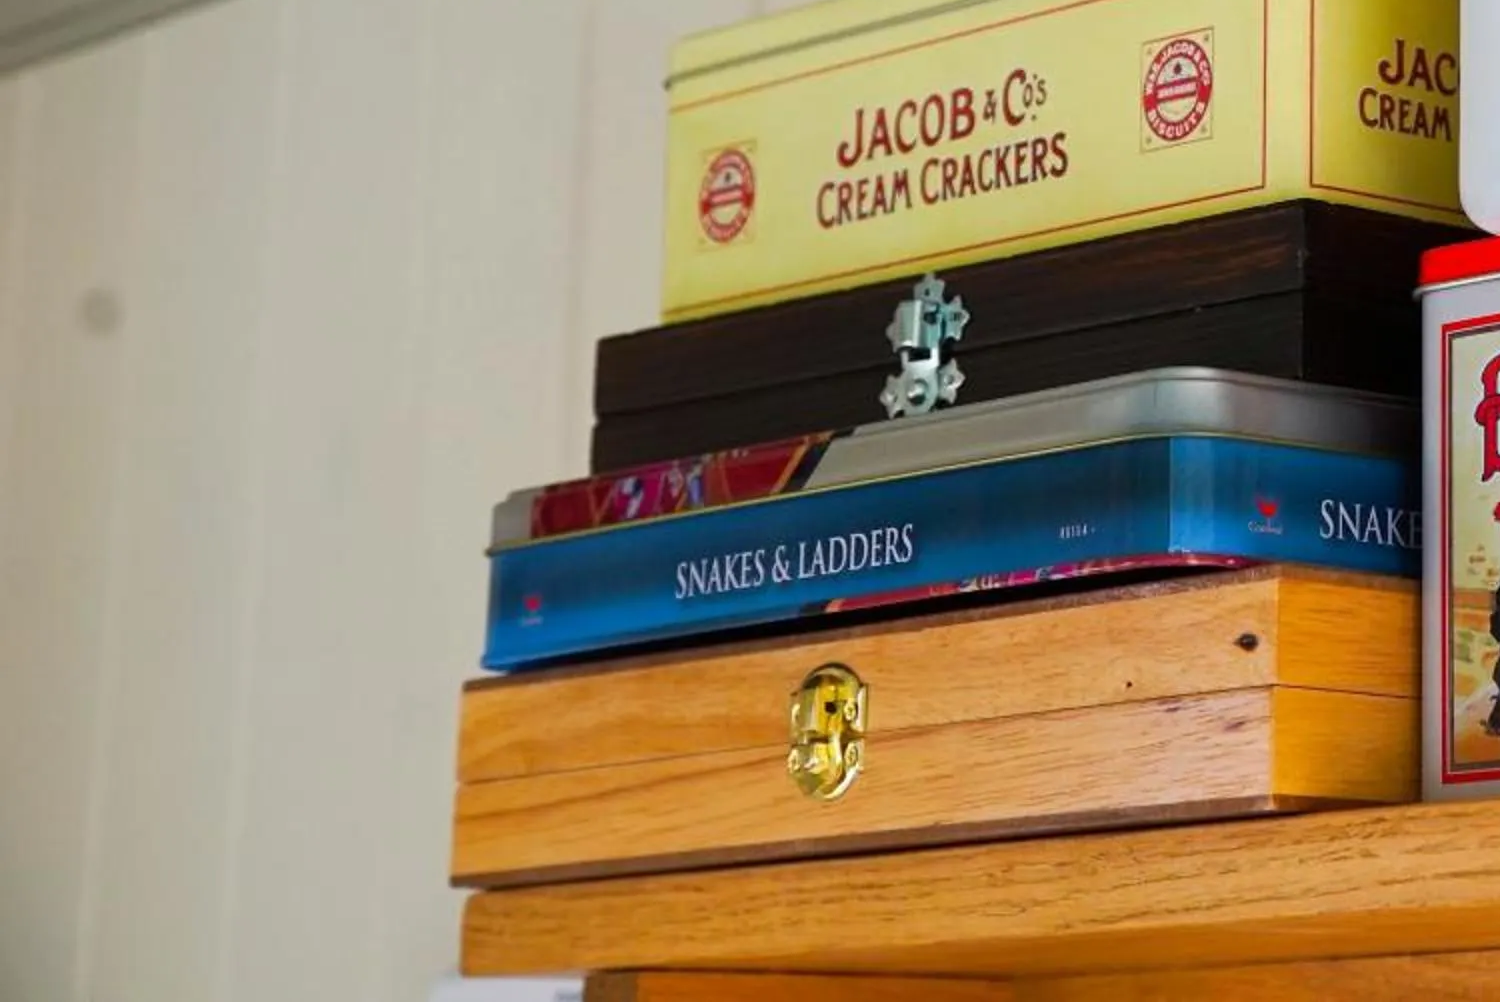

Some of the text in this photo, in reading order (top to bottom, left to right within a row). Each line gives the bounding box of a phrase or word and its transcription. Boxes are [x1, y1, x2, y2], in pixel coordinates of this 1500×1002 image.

[836, 87, 977, 168] JACOB
[982, 89, 997, 125] &
[1358, 87, 1453, 143] CREAM
[816, 168, 913, 229] CREAM
[920, 132, 1069, 205] CRACKERS
[675, 523, 914, 599] SNAKES & LADDERS
